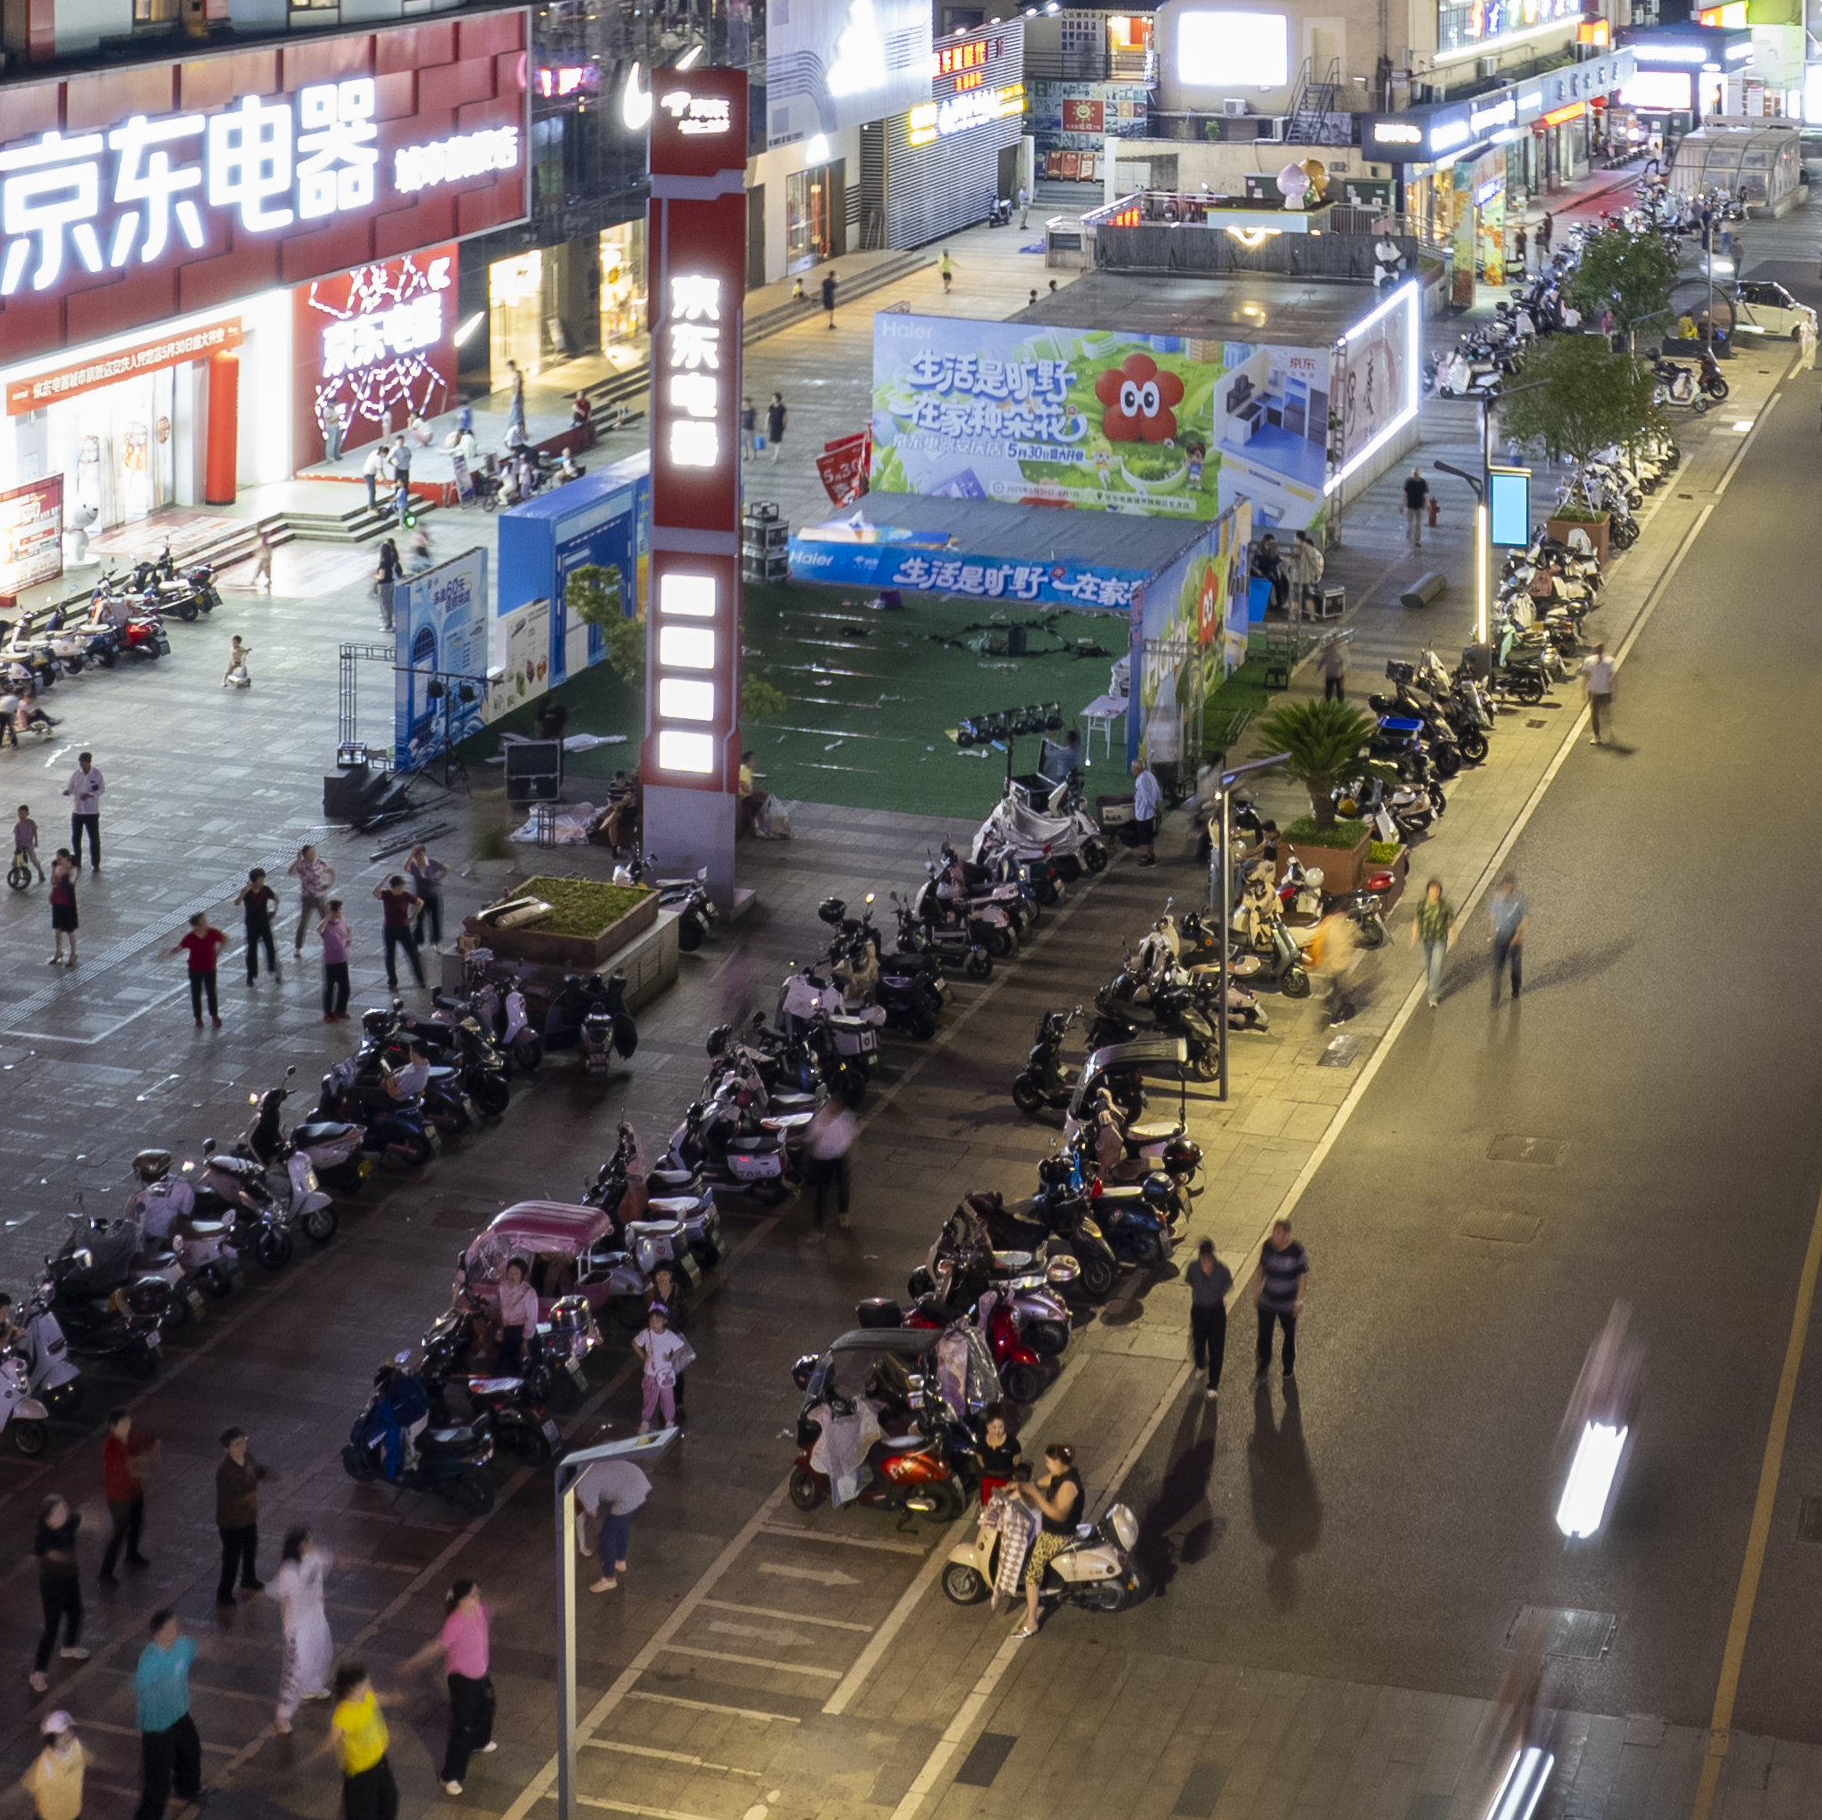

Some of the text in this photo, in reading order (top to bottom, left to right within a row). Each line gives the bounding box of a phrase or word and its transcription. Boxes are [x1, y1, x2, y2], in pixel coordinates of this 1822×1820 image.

[882, 319, 934, 340] Haier
[670, 274, 720, 468] 京东电器
[906, 348, 1078, 404] 生活是旷野
[1289, 357, 1316, 380] 京东
[888, 392, 1089, 444] 在家种朵花
[789, 550, 835, 568] Haier
[893, 556, 1132, 608] 生活是旷野 在家
[738, 1168, 778, 1178] TAILG
